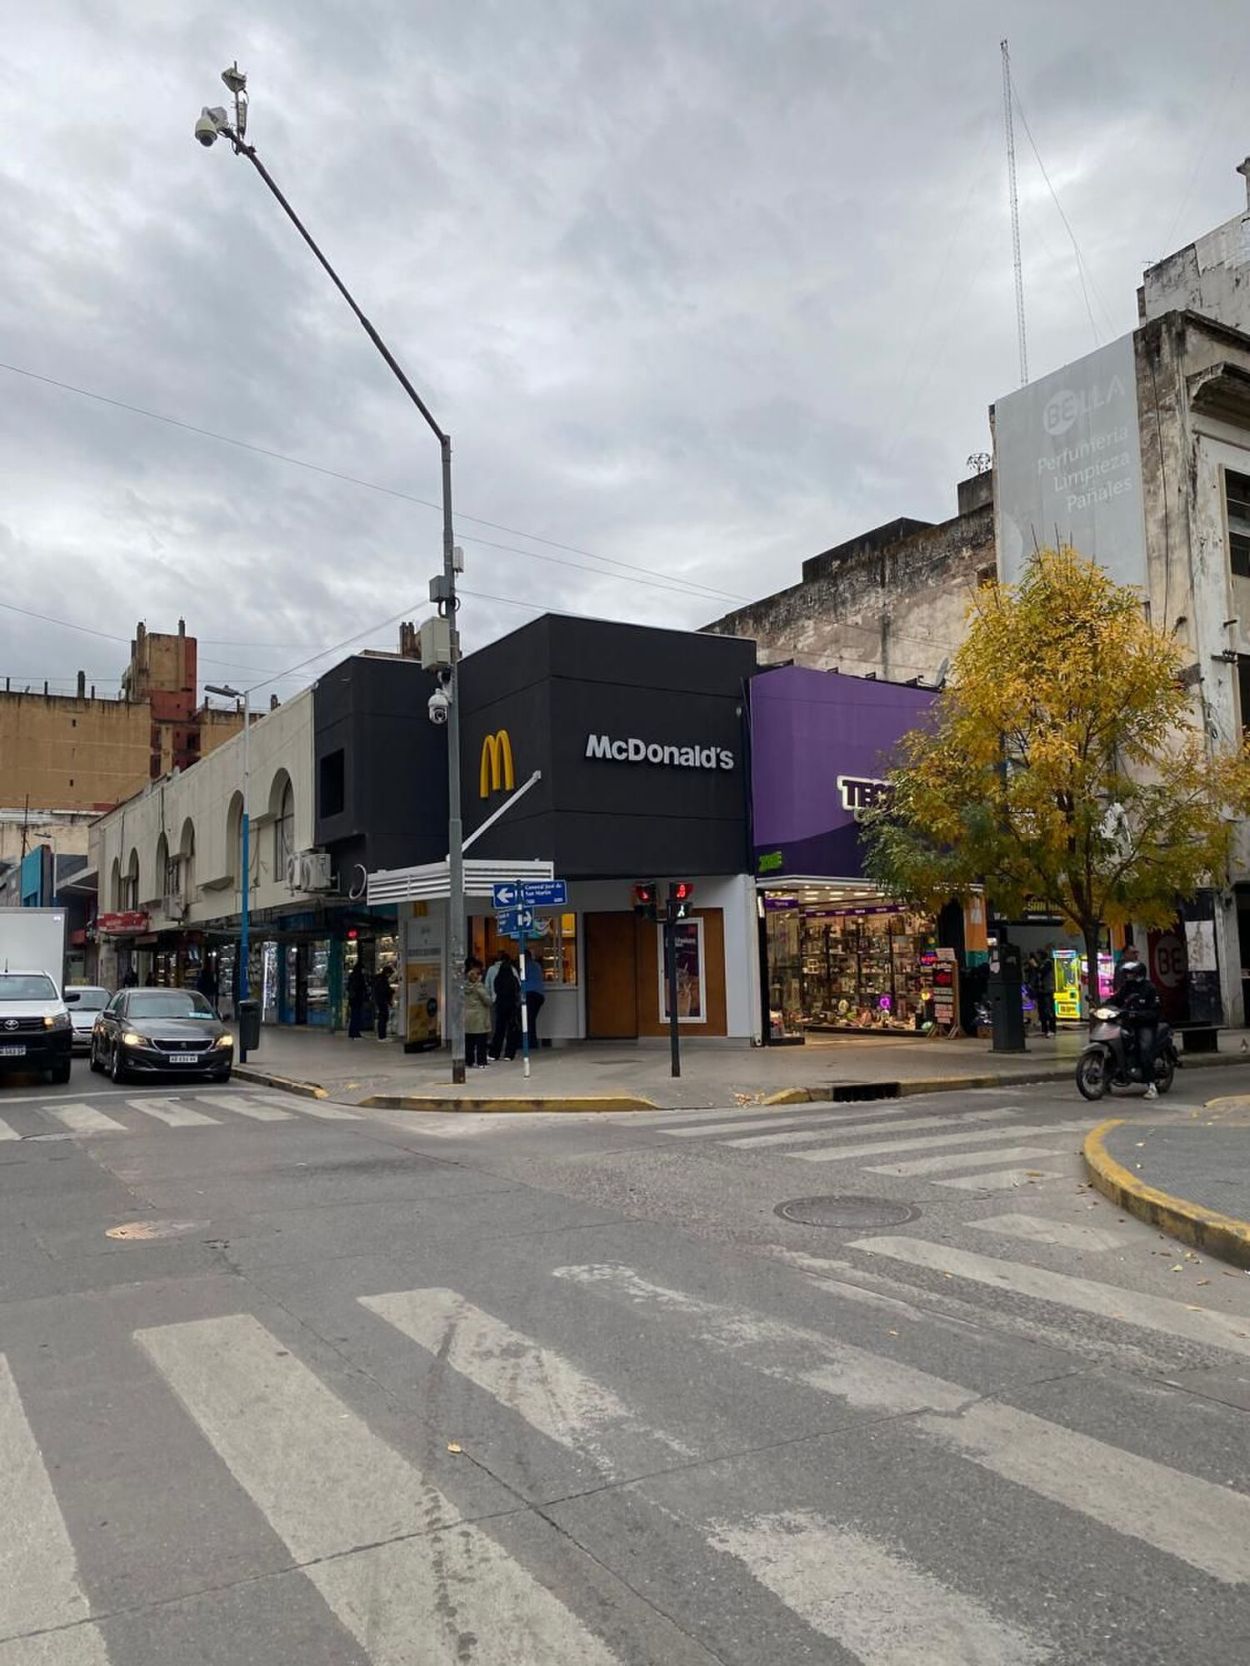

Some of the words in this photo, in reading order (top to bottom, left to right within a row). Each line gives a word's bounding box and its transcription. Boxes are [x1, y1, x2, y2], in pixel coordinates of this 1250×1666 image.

[1045, 374, 1125, 432] BELLA
[1053, 451, 1130, 492] Limpieza
[1066, 477, 1133, 512] Pañales
[585, 734, 734, 770] McDonald's
